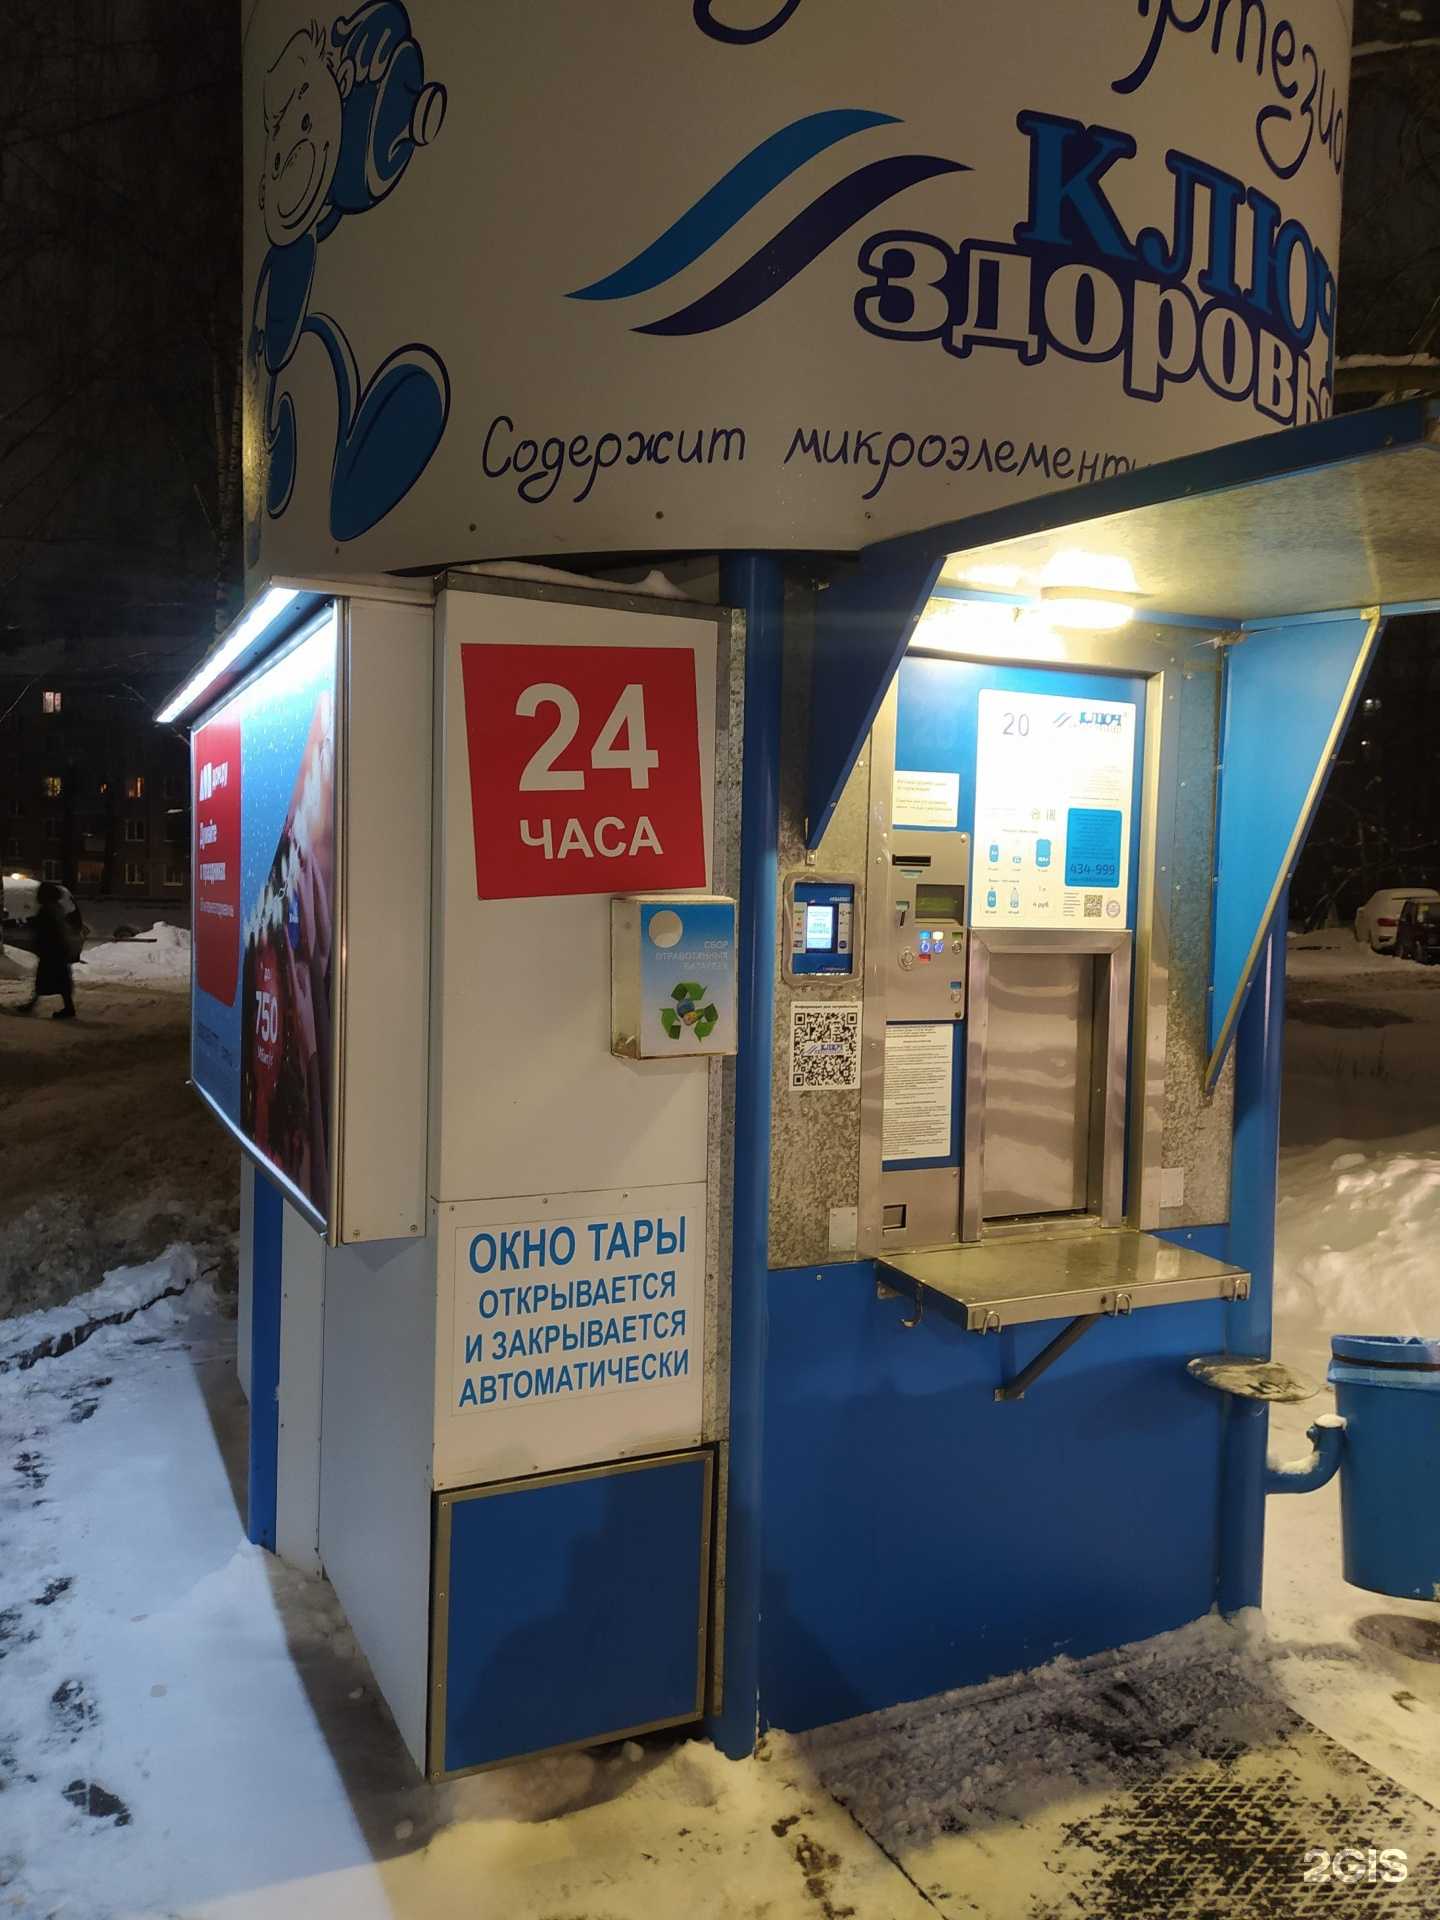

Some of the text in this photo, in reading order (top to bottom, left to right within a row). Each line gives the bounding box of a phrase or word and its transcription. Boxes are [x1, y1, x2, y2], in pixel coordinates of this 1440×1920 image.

[482, 415, 1137, 503] Содержит микроэлемент
[515, 682, 659, 791] 24
[519, 816, 664, 860] ЧАСА
[256, 990, 278, 1044] 750
[469, 1216, 686, 1274] ОКНО ТАРЫ
[479, 1270, 676, 1319] ОТКРЫВАЕТСЯ
[465, 1309, 686, 1363] И ЗАКРЫВАЕТСЯ
[458, 1349, 689, 1407] АВТОМАТИЧЕСКИ
